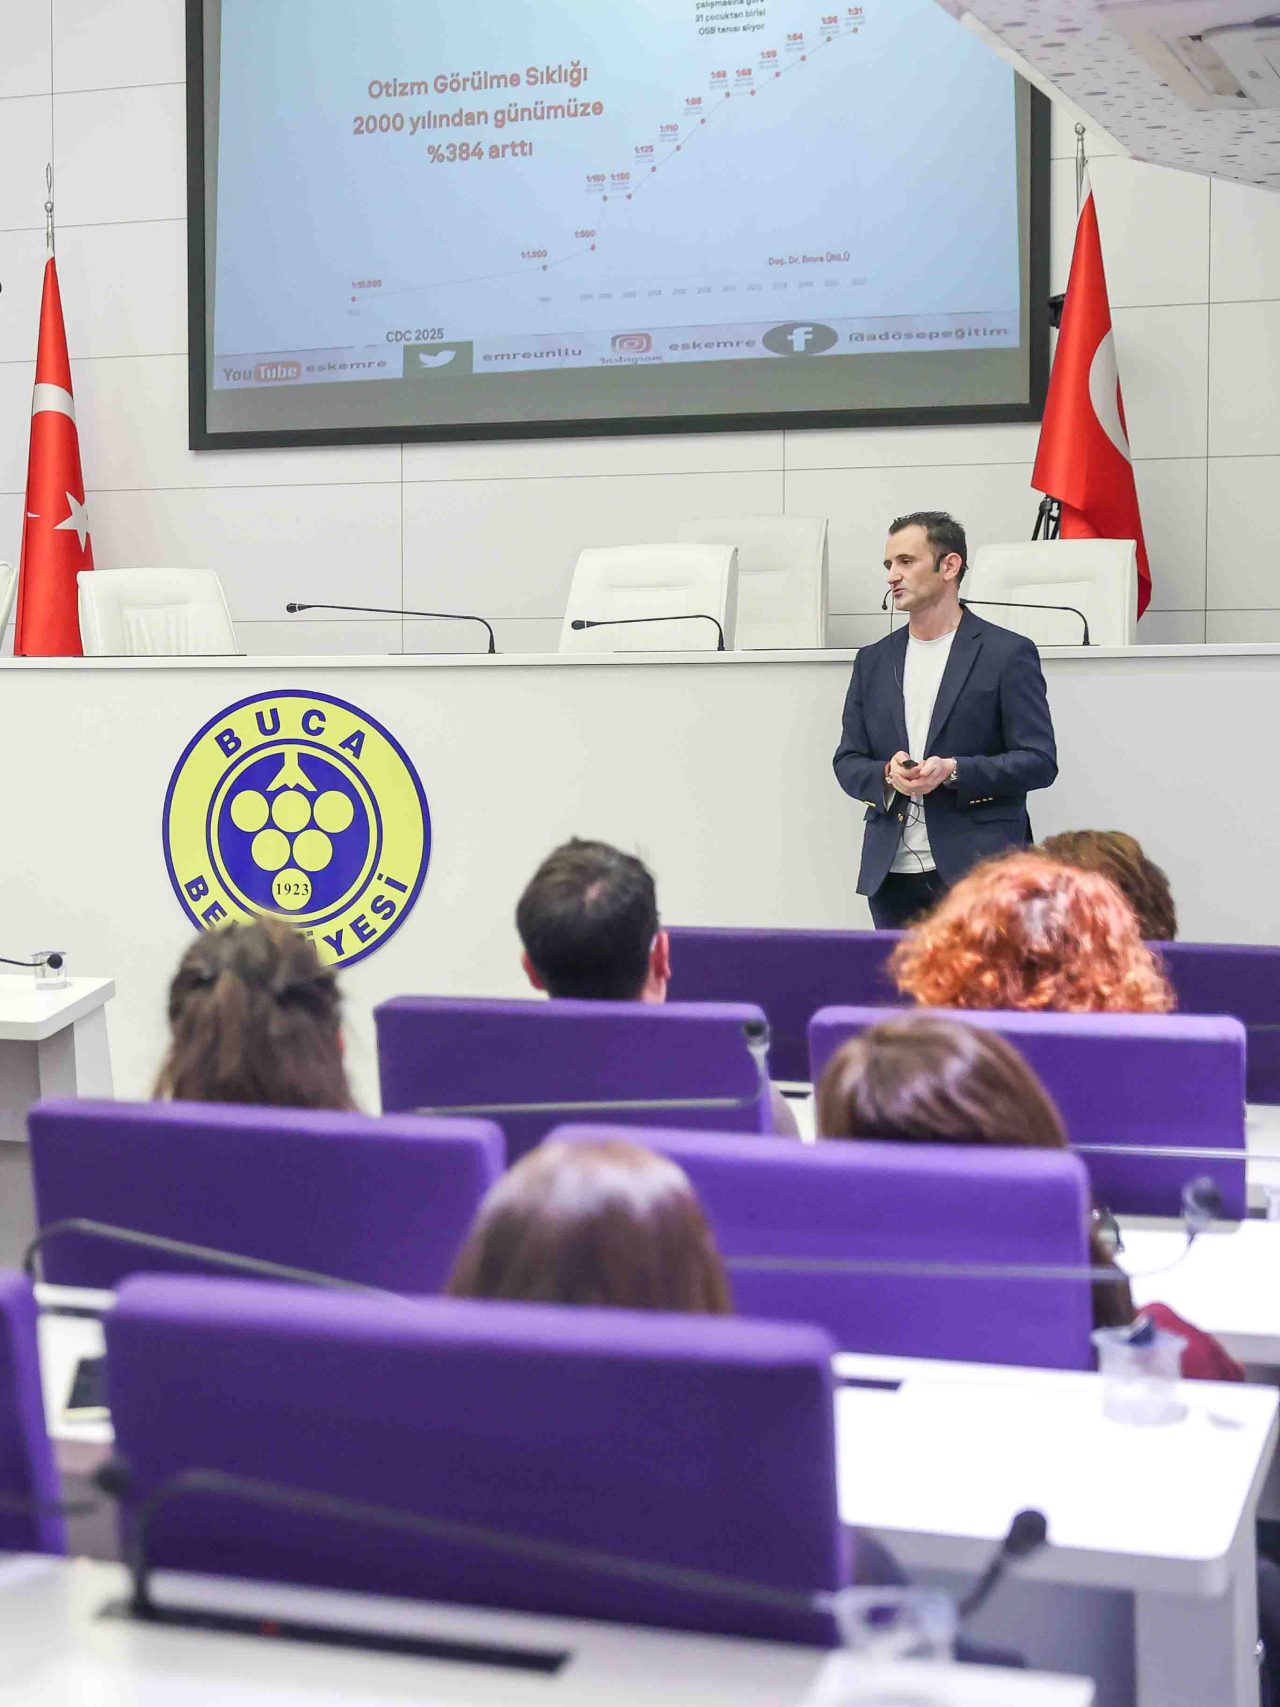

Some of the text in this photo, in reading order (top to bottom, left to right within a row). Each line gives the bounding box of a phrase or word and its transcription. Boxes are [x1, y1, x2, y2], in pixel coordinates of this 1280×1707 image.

[368, 60, 588, 99] Otizm Görülme Sıklığı
[353, 98, 604, 136] 2000 yılından günümüze
[427, 139, 533, 164] %384 arttı
[788, 256, 800, 265] Dr.
[385, 328, 444, 343] CDC 2025
[669, 338, 756, 351] eskemre
[306, 360, 387, 373] eskemre
[215, 708, 366, 760] BUCA
[275, 883, 310, 896] 1923
